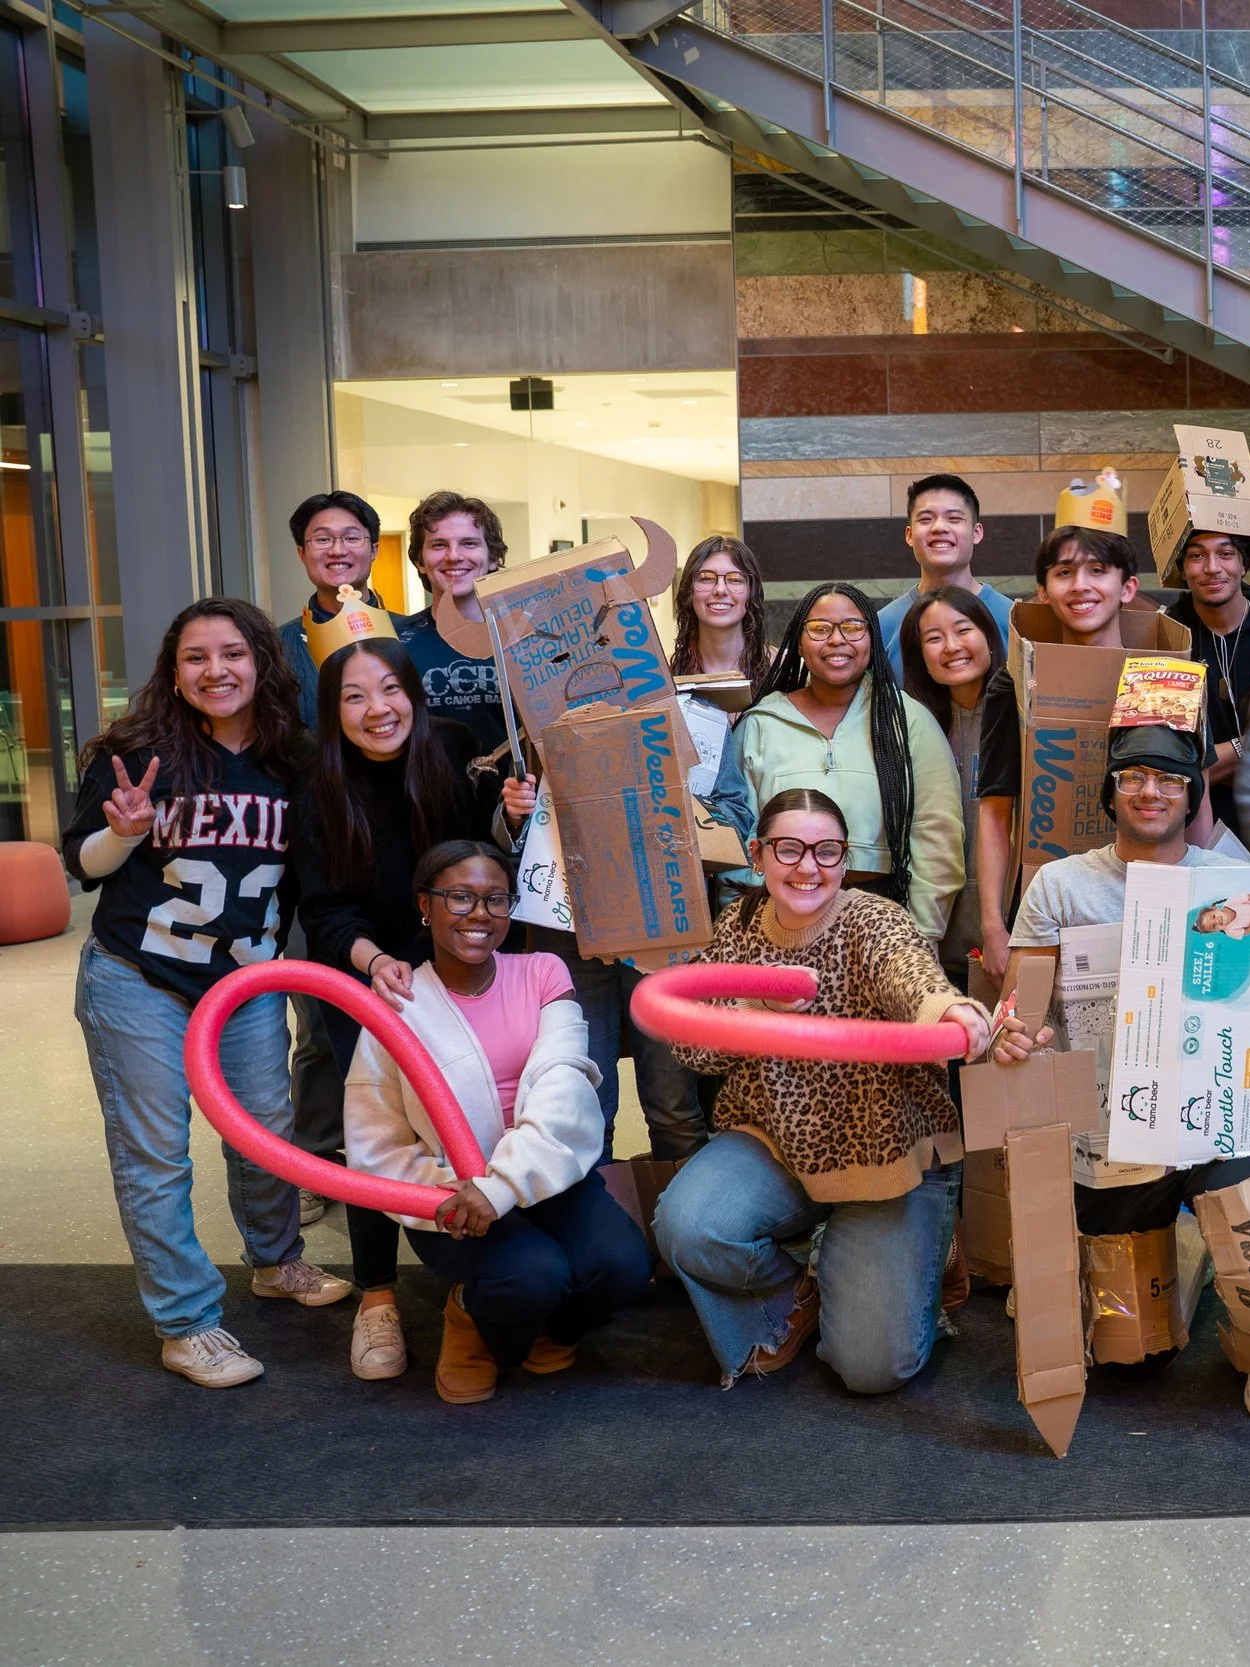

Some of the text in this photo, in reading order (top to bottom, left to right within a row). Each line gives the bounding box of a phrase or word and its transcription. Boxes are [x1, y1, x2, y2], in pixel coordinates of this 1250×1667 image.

[1206, 439, 1222, 449] 28
[427, 694, 503, 707] LE CANOE BA
[1124, 671, 1198, 684] TAQUITOS
[641, 714, 681, 819] Weee!
[1028, 728, 1077, 860] Weee!
[152, 794, 290, 852] MEXIC
[543, 860, 557, 902] mama bear
[140, 857, 281, 966] 23
[1192, 958, 1203, 985] SIZE
[1202, 941, 1214, 994] TAILLE 6
[1148, 1080, 1159, 1129] mama bear
[1203, 1089, 1213, 1136] mama bear
[1214, 1026, 1235, 1157] Gentle Touch
[1151, 1278, 1160, 1297] 5
